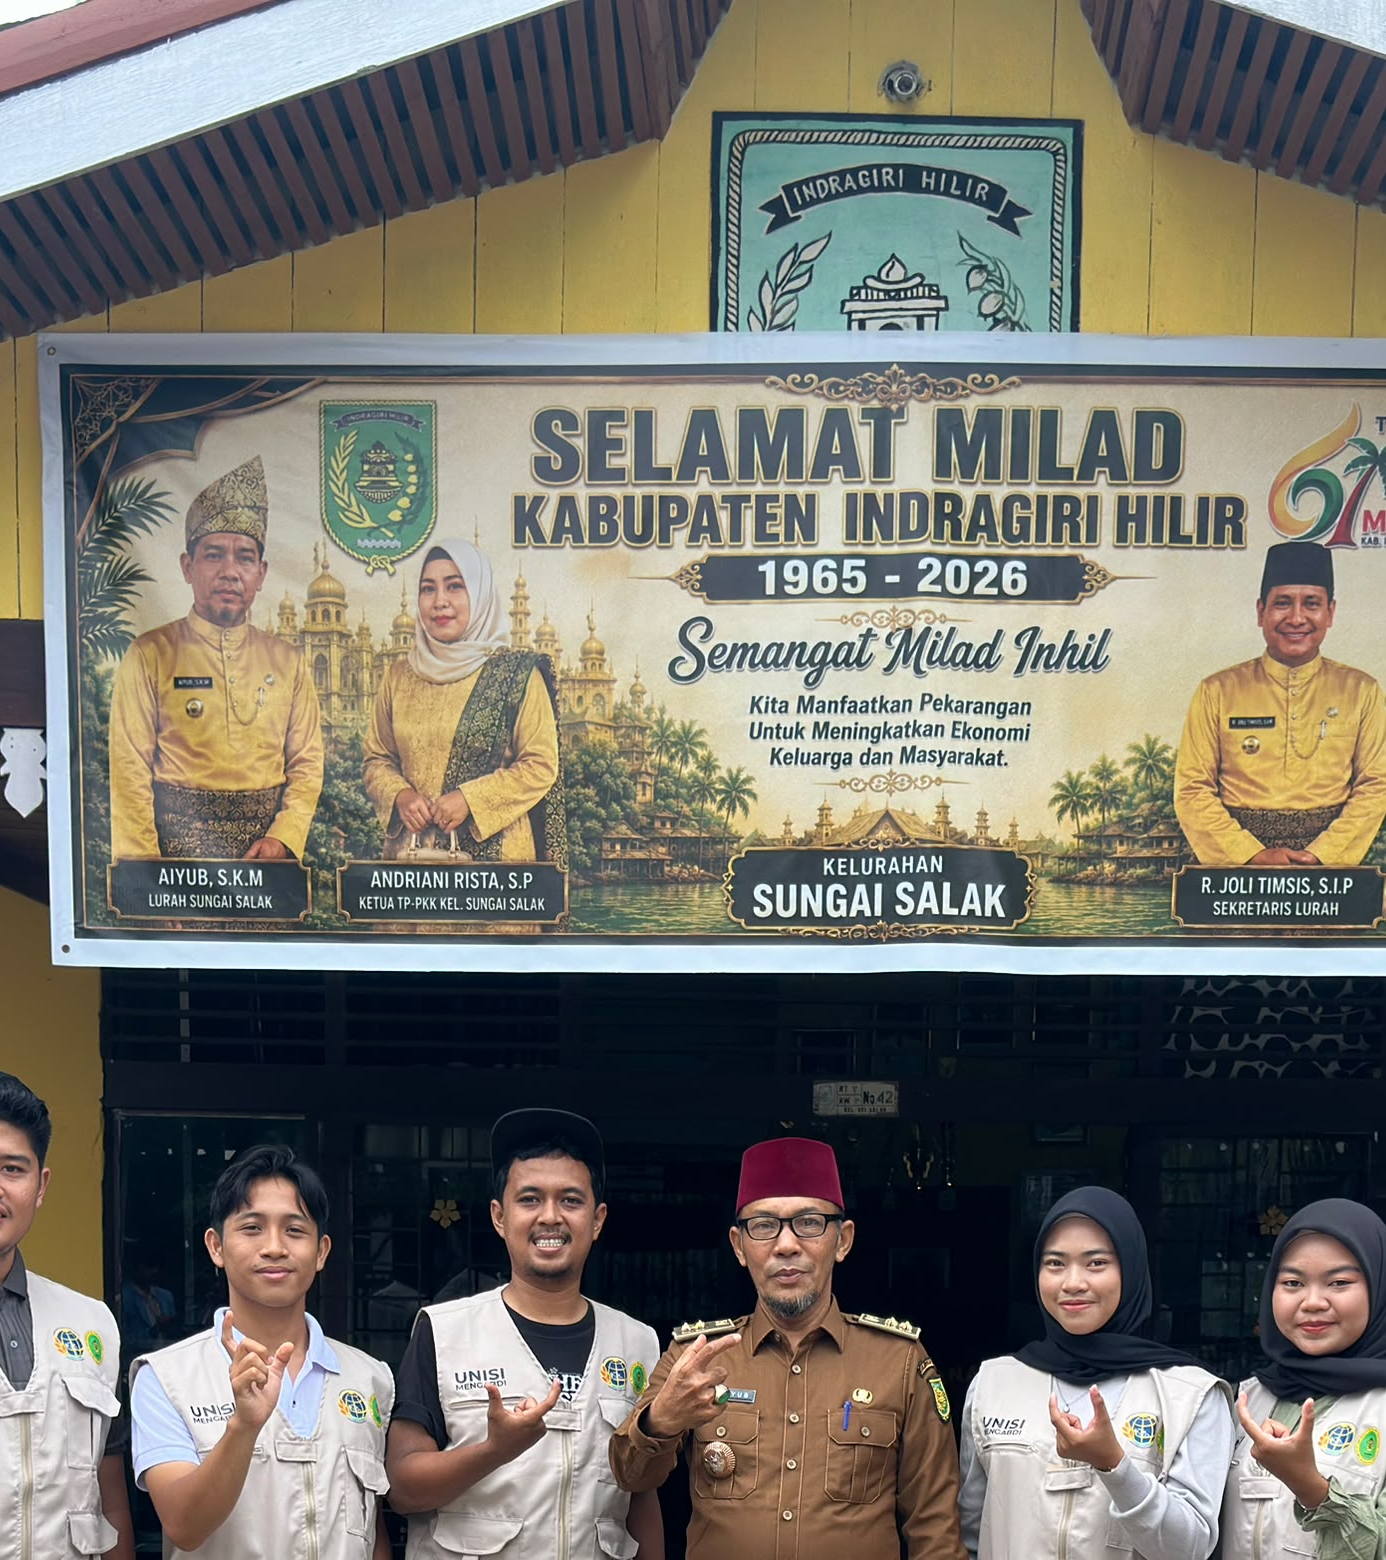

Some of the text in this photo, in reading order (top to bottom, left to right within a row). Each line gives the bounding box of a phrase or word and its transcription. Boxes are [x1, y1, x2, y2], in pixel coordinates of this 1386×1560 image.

[793, 167, 990, 206] INDRAGIRI HILIR
[531, 405, 1186, 485] SELAMAT MILAD
[511, 489, 1248, 548] KABUPATEN INDRAGIRI HILIR
[1361, 537, 1382, 546] KAB.
[758, 559, 867, 596] 1965
[917, 556, 1028, 596] 2026
[667, 616, 1112, 689] Semangat Milad Inhil
[749, 693, 1032, 720] Kita Manfaatkan Pekarangan
[749, 720, 1031, 744] Untuk Meningkatkan Ekonomi
[769, 745, 1009, 770] Keluarga dan Masyarakat.
[823, 855, 943, 876] KELURAHAN
[158, 868, 263, 888] AIYUB, S.K.M
[370, 870, 533, 892] ANDRIANI RISTA, S.P
[1201, 876, 1354, 897] R. JOLI TIMSIS, S.I.P
[148, 893, 273, 909] LURAH SUNGAI SALAK
[359, 896, 545, 911] KETUA TP-PKK KEL. SUNGAI SALAK
[752, 881, 1006, 918] SUNGAI SALAK
[1213, 901, 1339, 916] SEKRETARIS LURAH
[454, 1367, 505, 1384] UNISI
